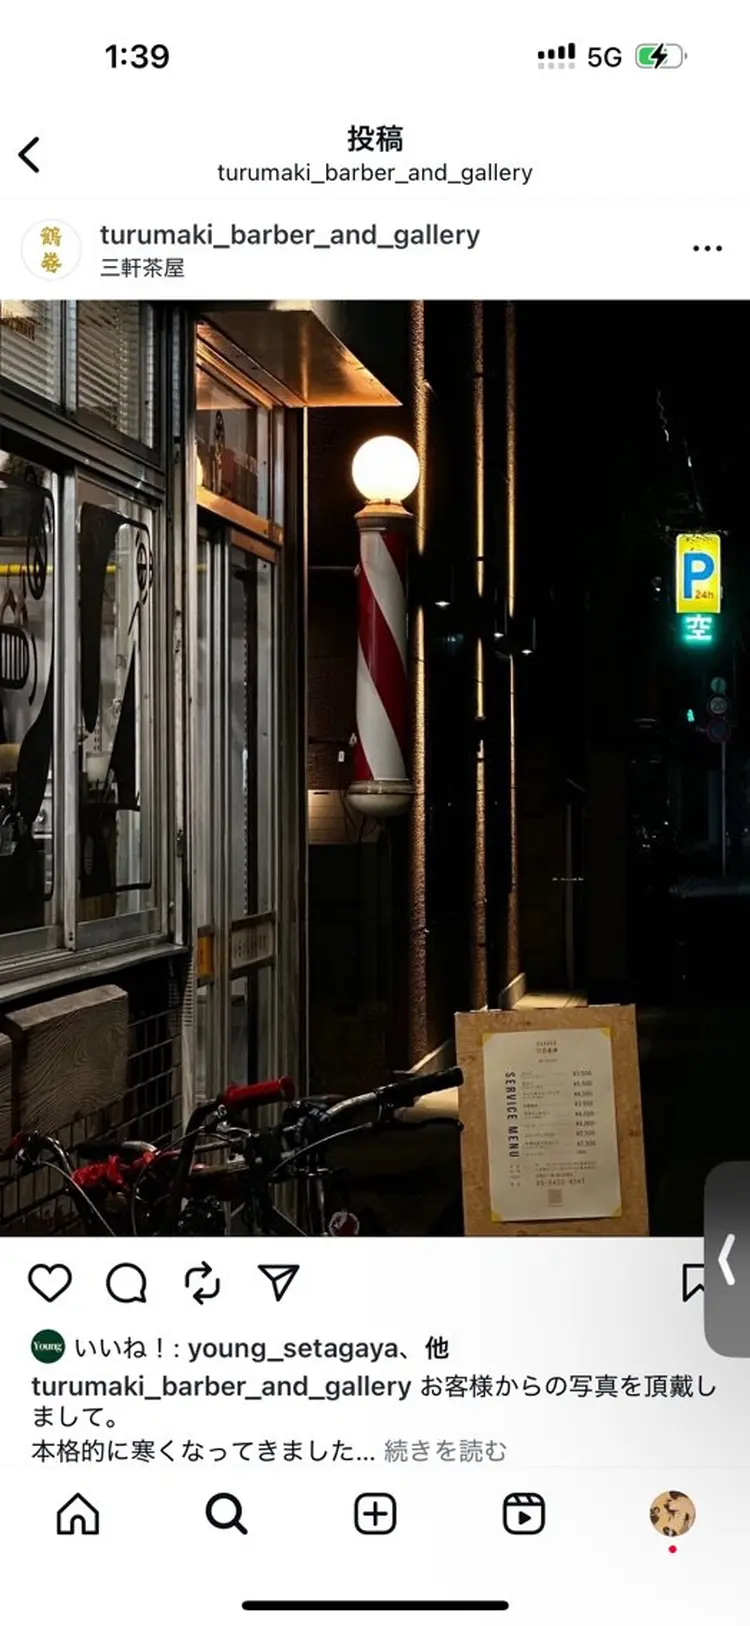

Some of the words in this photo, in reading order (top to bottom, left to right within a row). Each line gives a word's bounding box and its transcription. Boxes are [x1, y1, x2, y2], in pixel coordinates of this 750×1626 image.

[684, 552, 714, 599] P
[695, 590, 714, 599] 24h
[685, 614, 712, 640] 空
[505, 1072, 517, 1120] SERVICE
[508, 1126, 520, 1158] MENU
